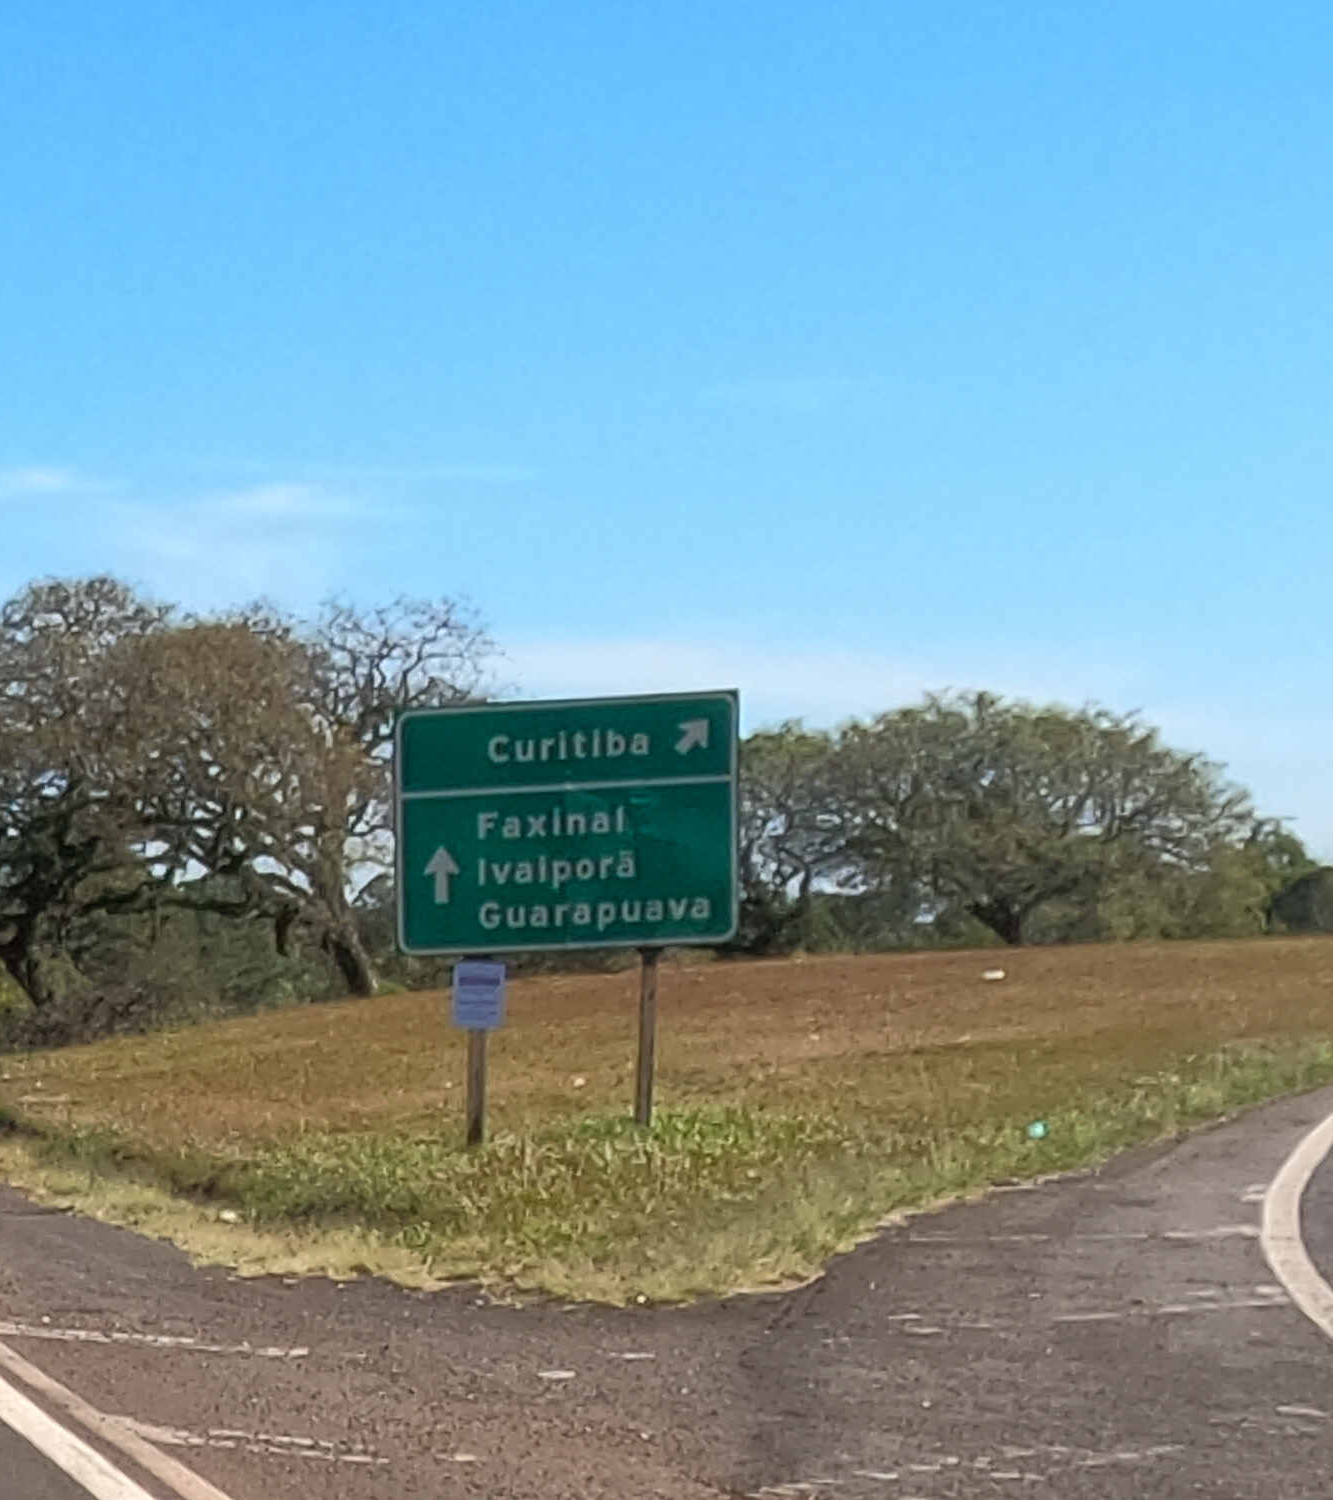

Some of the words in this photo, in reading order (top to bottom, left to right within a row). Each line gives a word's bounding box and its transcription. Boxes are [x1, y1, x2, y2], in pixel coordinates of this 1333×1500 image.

[487, 730, 650, 763] Curitiba
[476, 806, 625, 840] Faxinal
[479, 894, 712, 931] Guarapuava
